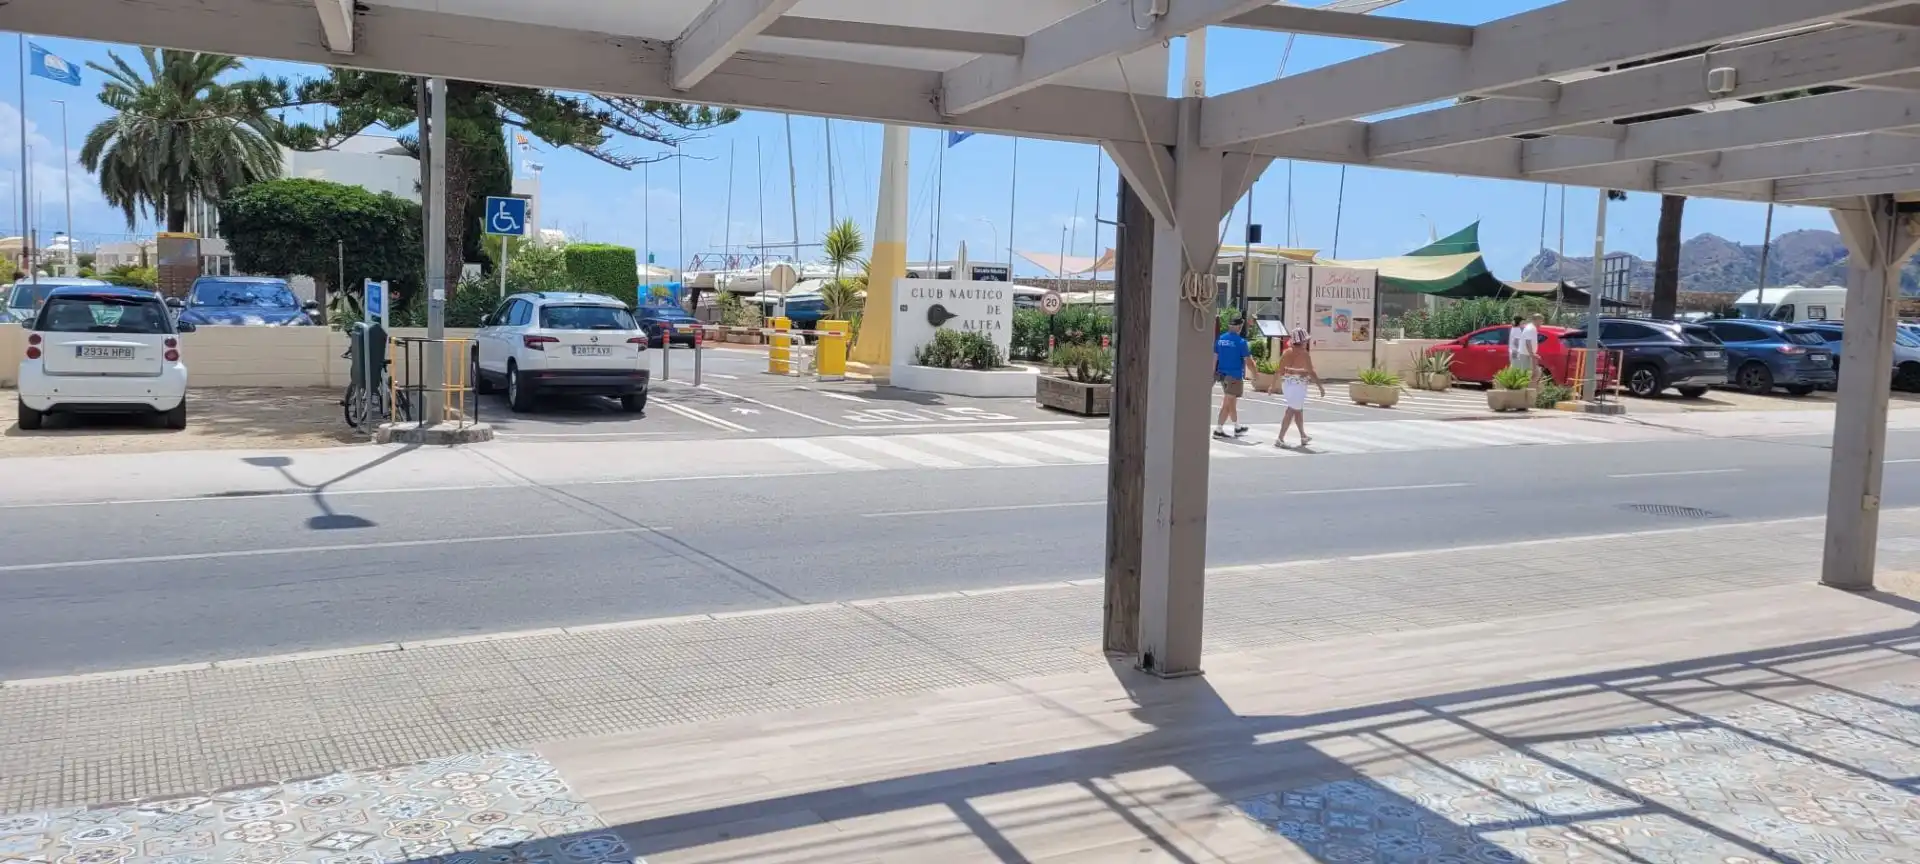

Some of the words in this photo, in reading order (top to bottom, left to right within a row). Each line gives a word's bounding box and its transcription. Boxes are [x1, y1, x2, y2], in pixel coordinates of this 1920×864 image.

[911, 287, 943, 297] CLUB
[949, 289, 1003, 300] NAUTICO
[1046, 298, 1057, 308] 20
[987, 304, 1002, 315] DE
[963, 319, 1002, 330] ALTEA
[83, 346, 109, 357] 2934
[111, 348, 131, 357] HPB
